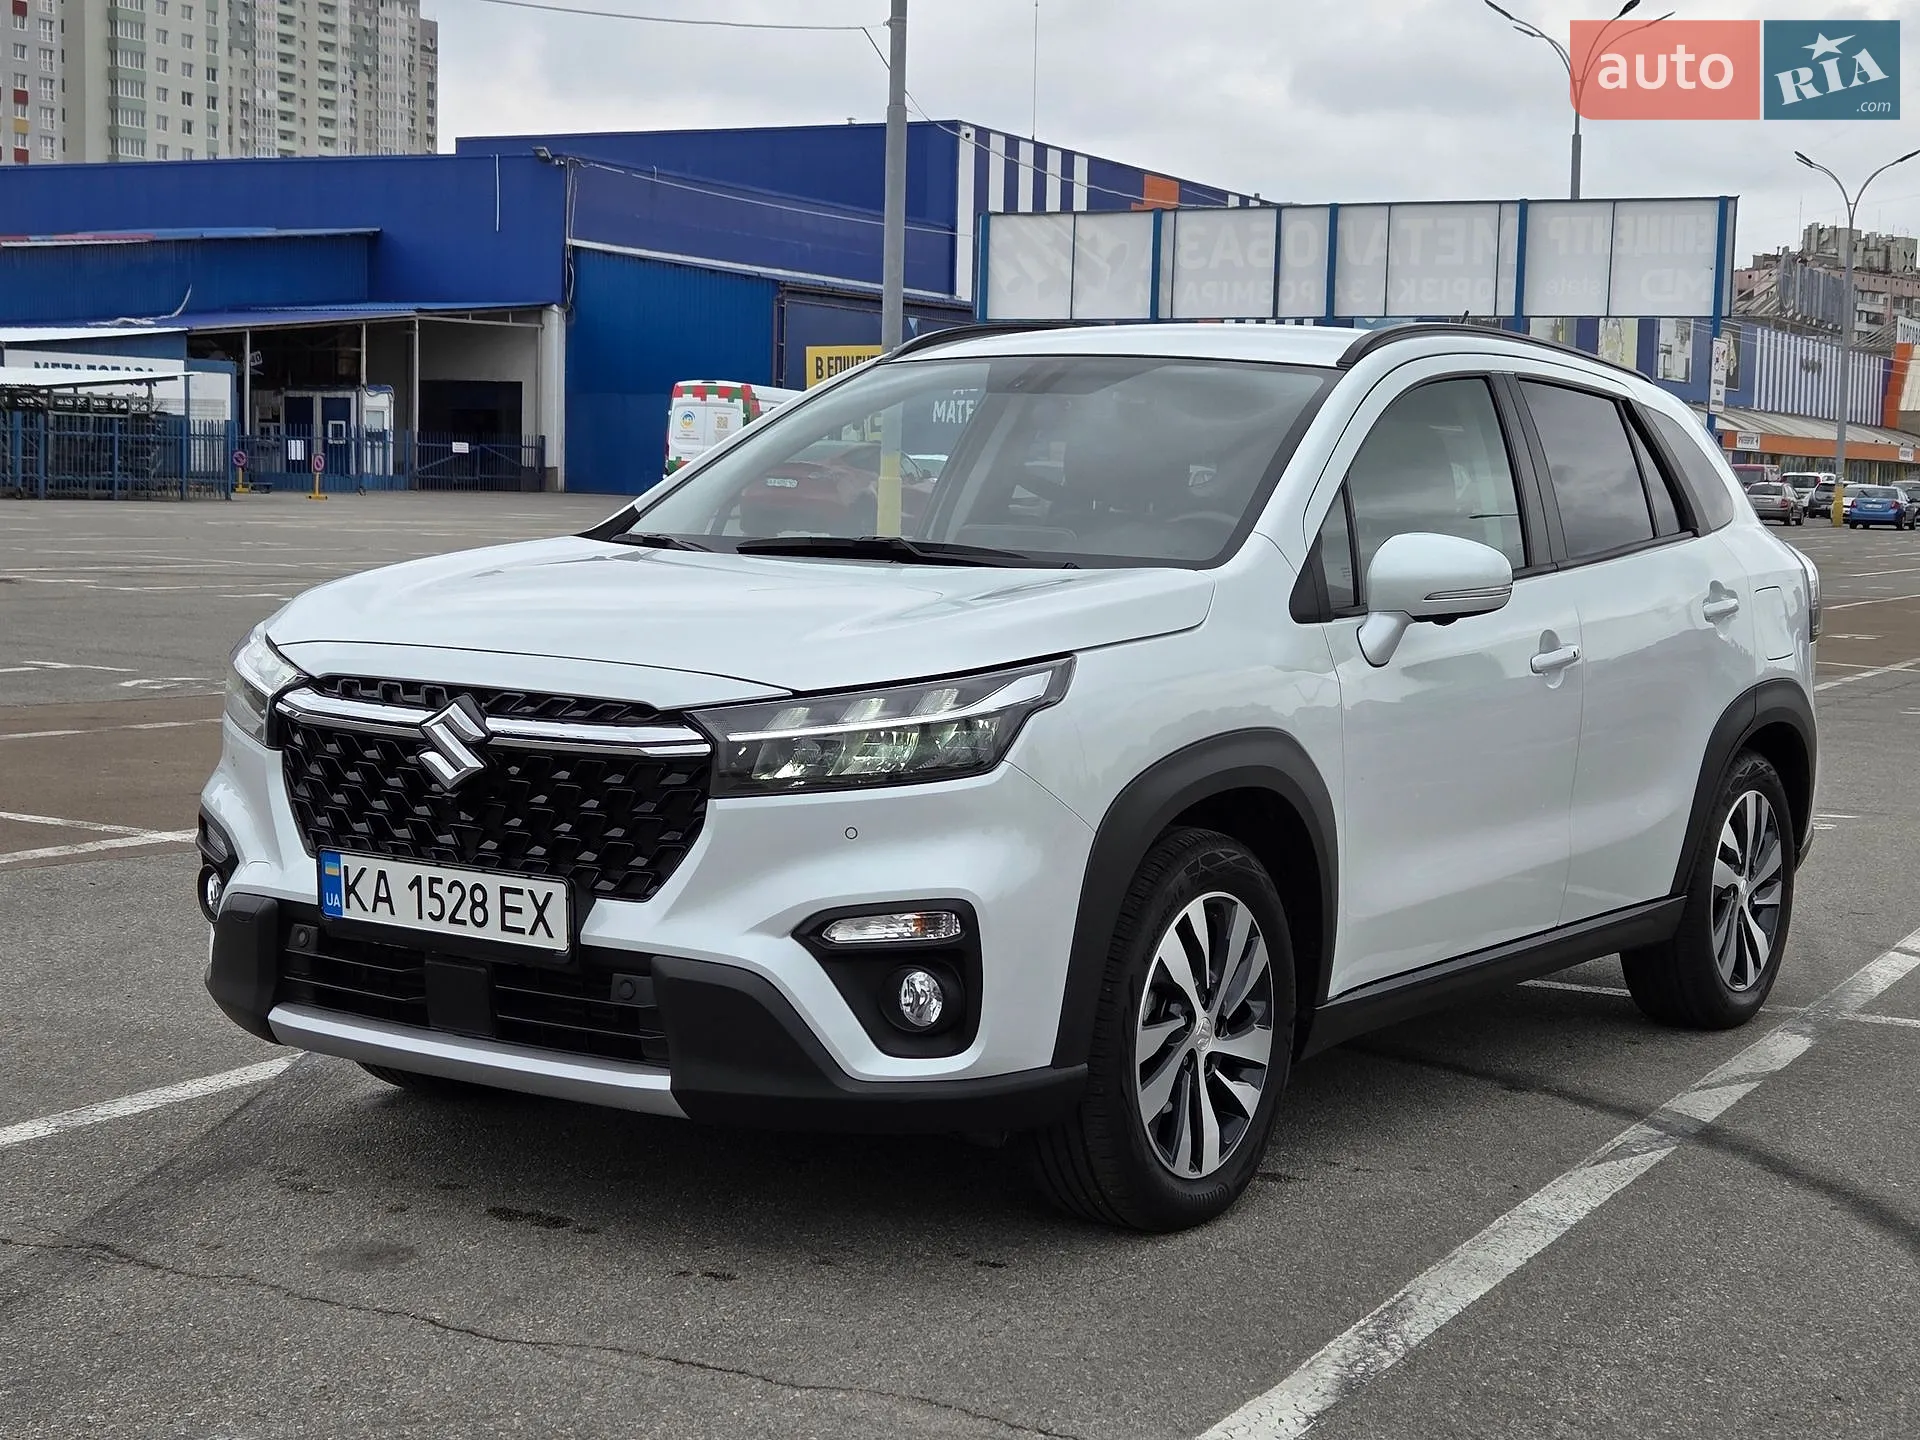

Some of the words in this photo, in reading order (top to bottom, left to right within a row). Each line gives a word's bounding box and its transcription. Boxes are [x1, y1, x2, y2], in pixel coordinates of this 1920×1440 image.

[815, 356, 823, 379] В
[325, 892, 341, 908] UA
[407, 874, 489, 928] 1528
